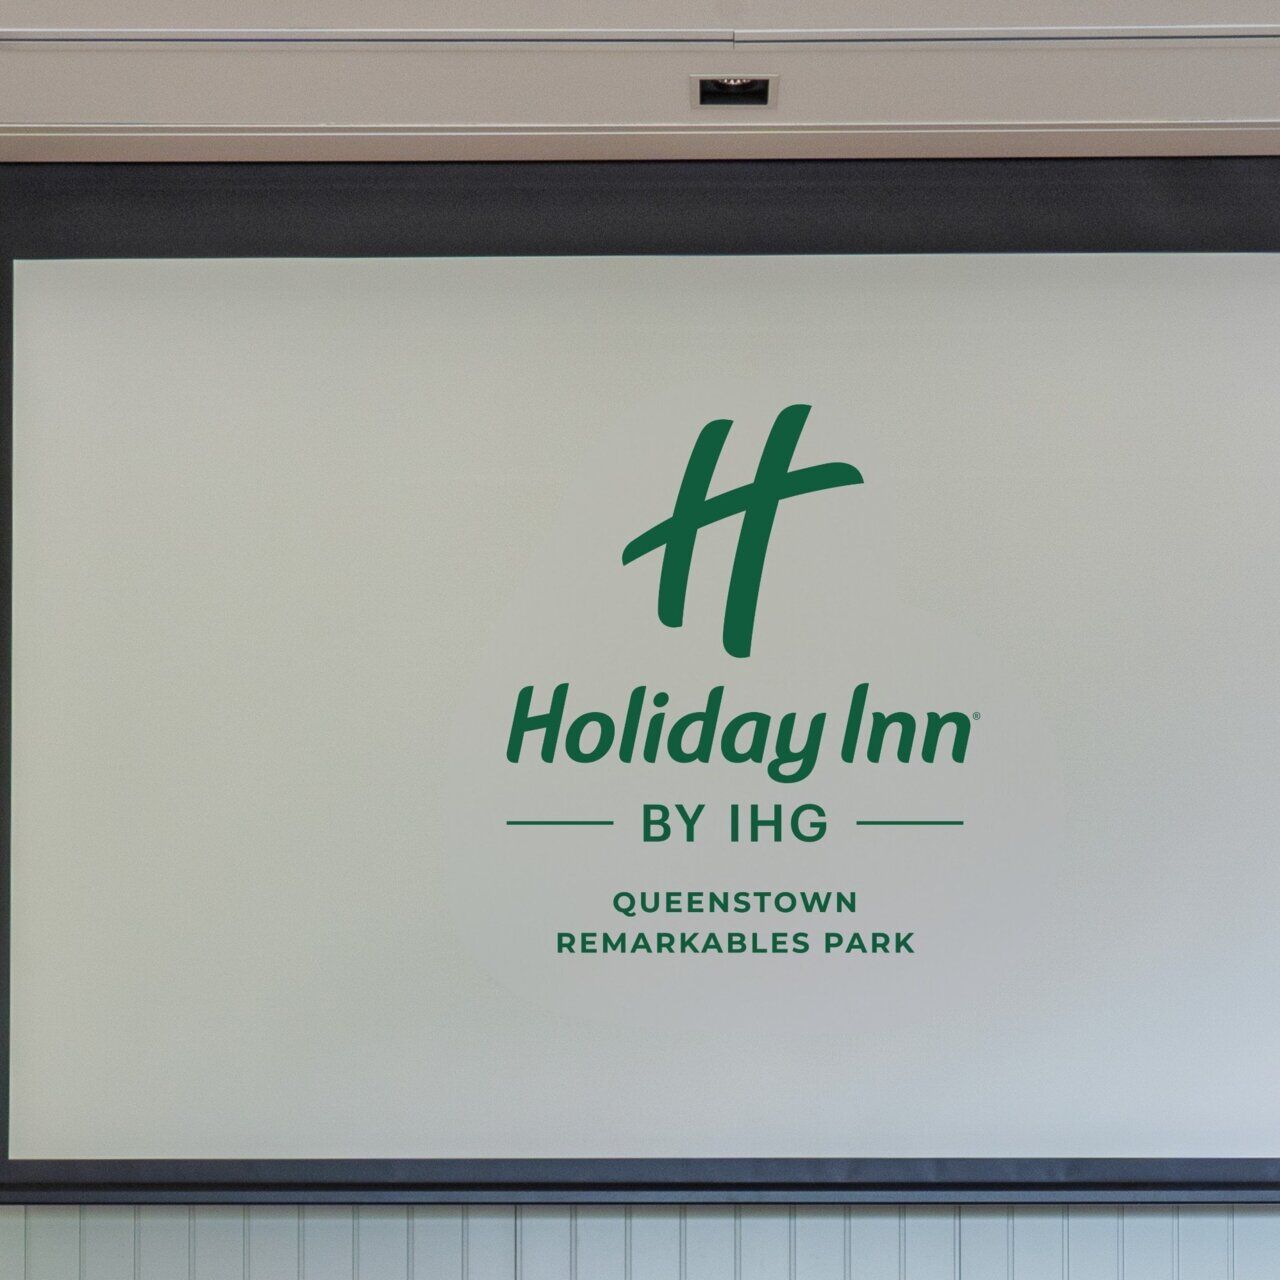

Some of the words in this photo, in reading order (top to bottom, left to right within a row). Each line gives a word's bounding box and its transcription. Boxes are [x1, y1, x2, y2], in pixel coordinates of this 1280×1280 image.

[621, 403, 865, 659] H
[506, 682, 827, 784] Holiday
[642, 803, 706, 843] BY
[730, 803, 827, 843] IHG
[612, 891, 857, 918] QUEENSTOWN
[557, 931, 810, 954] REMARKABLES
[824, 932, 915, 954] PARK
